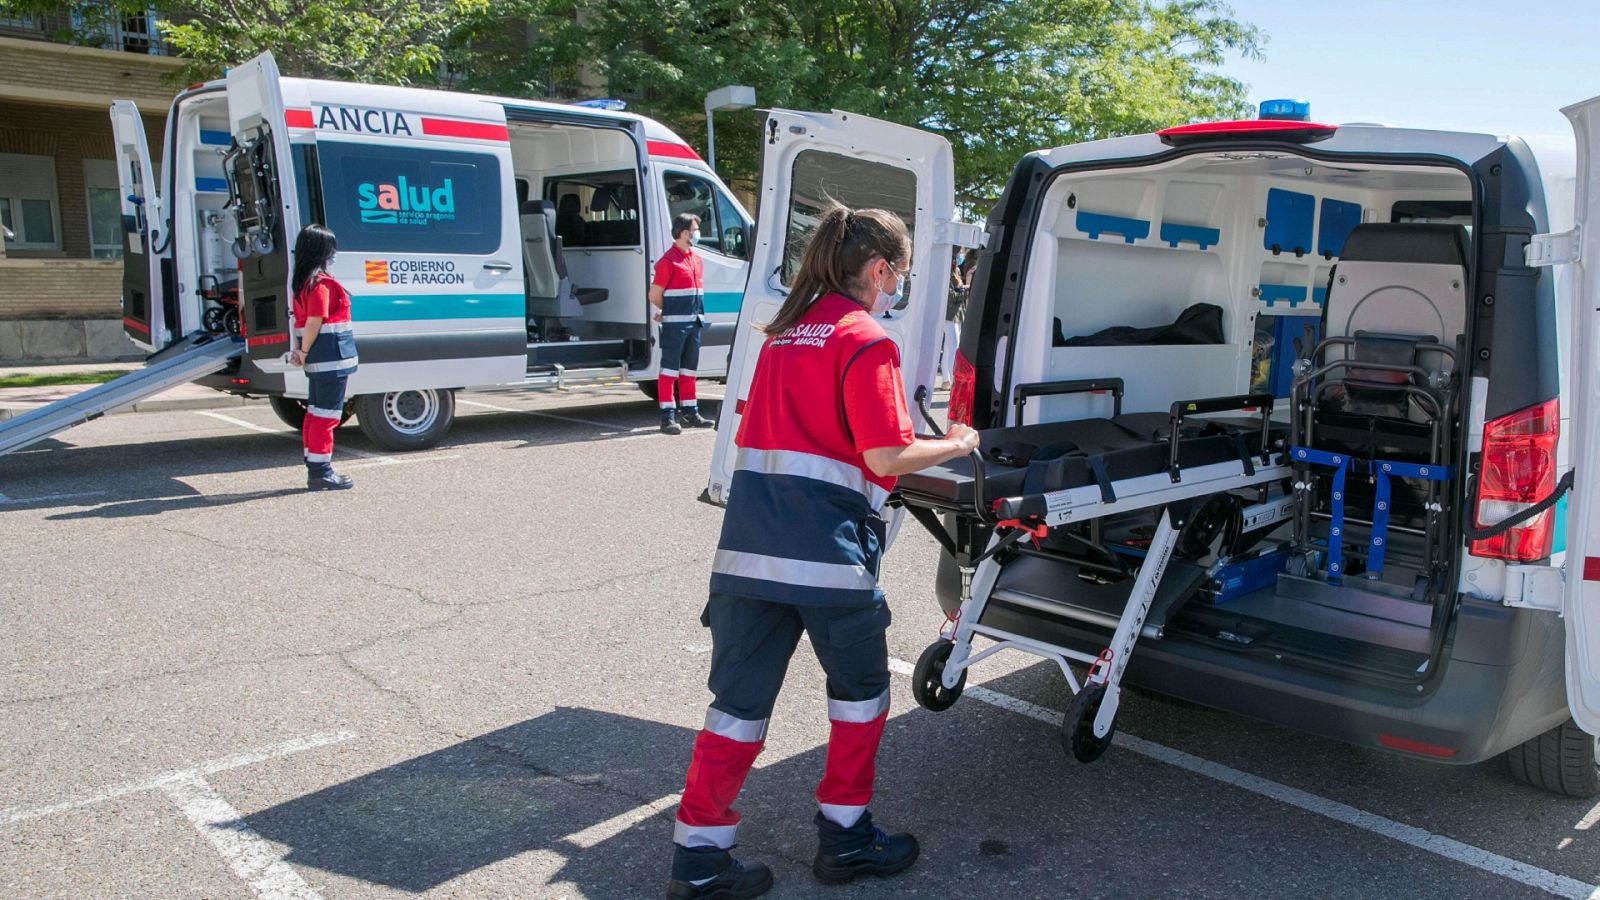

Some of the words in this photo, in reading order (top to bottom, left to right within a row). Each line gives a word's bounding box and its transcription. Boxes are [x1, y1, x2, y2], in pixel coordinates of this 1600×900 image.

[313, 105, 412, 136] ANCIA
[358, 175, 455, 212] salud
[399, 211, 424, 219] servicio
[409, 217, 427, 225] salud
[389, 260, 455, 272] GOBIERNO
[390, 273, 408, 284] DE
[412, 273, 465, 285] ARAGON
